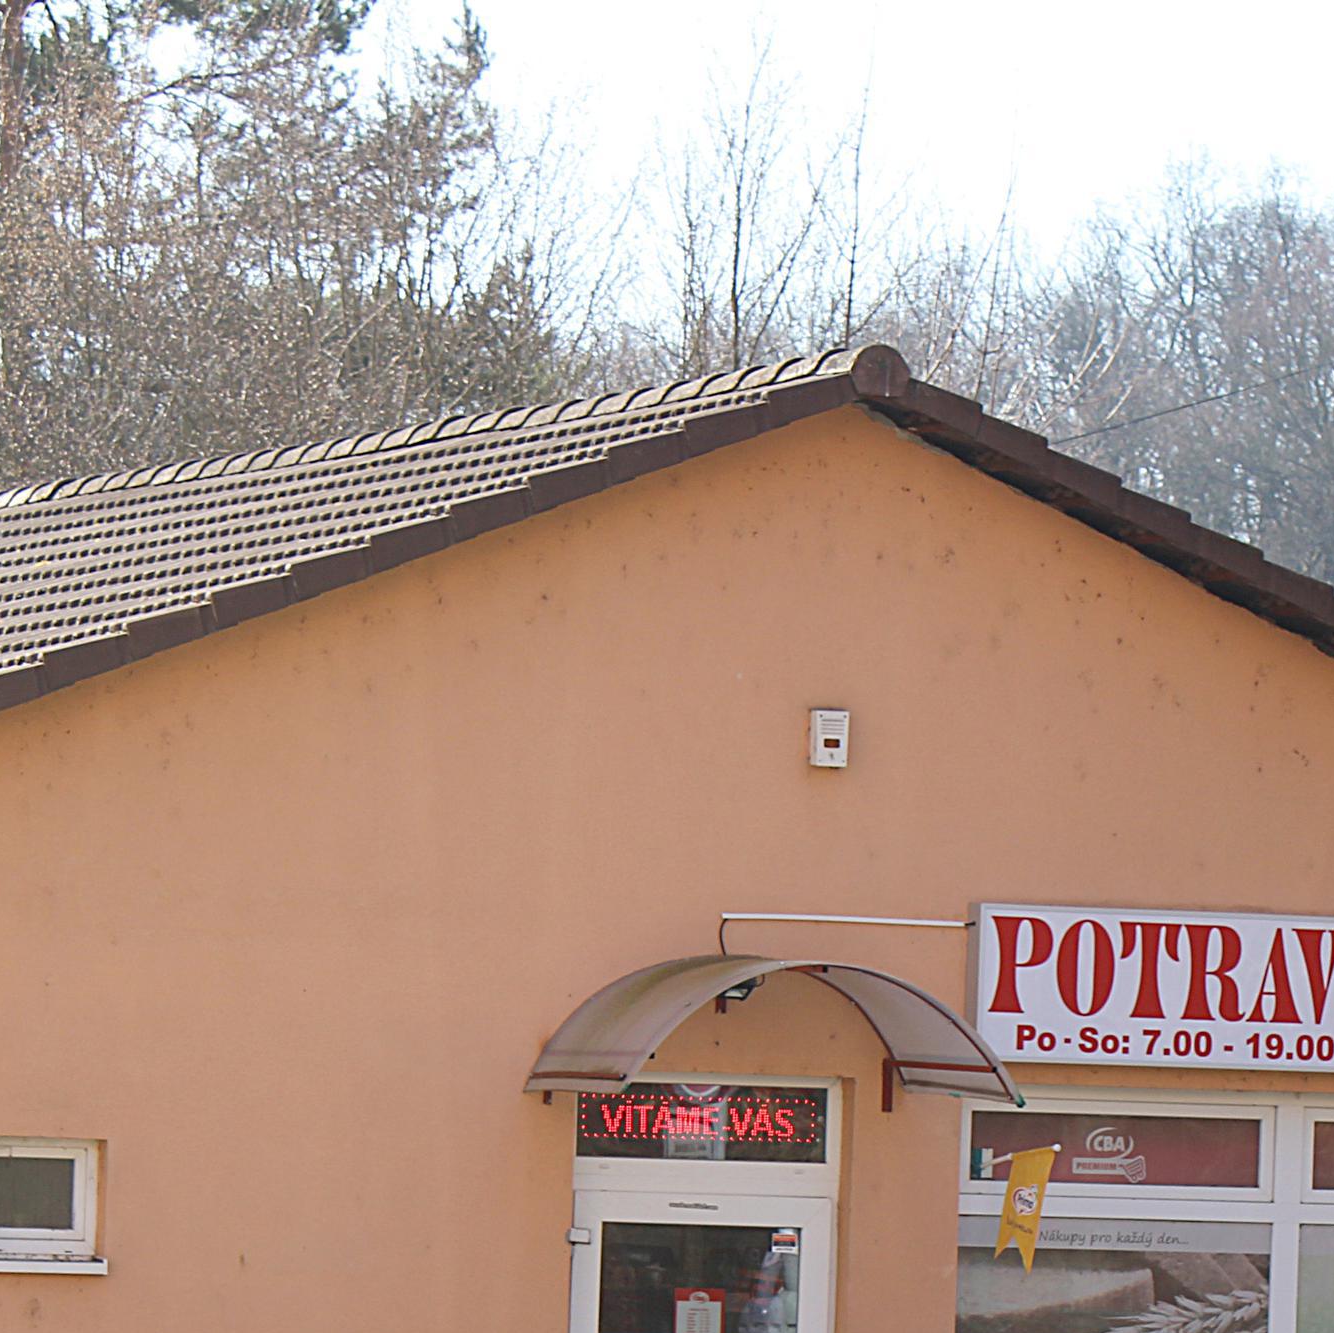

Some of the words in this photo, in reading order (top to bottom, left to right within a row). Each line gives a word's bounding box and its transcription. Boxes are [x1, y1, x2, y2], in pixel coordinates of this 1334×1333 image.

[1142, 1030, 1213, 1057] 7.00
[1246, 1033, 1334, 1061] 19.00
[601, 1100, 718, 1135] VÍTÁME
[730, 1104, 794, 1137] VÁS
[1094, 1136, 1125, 1151] CBA
[1076, 1162, 1117, 1171] PREMIUM
[1039, 1230, 1086, 1246] Nákupy
[1091, 1234, 1112, 1246] pro
[1117, 1231, 1153, 1246] každý
